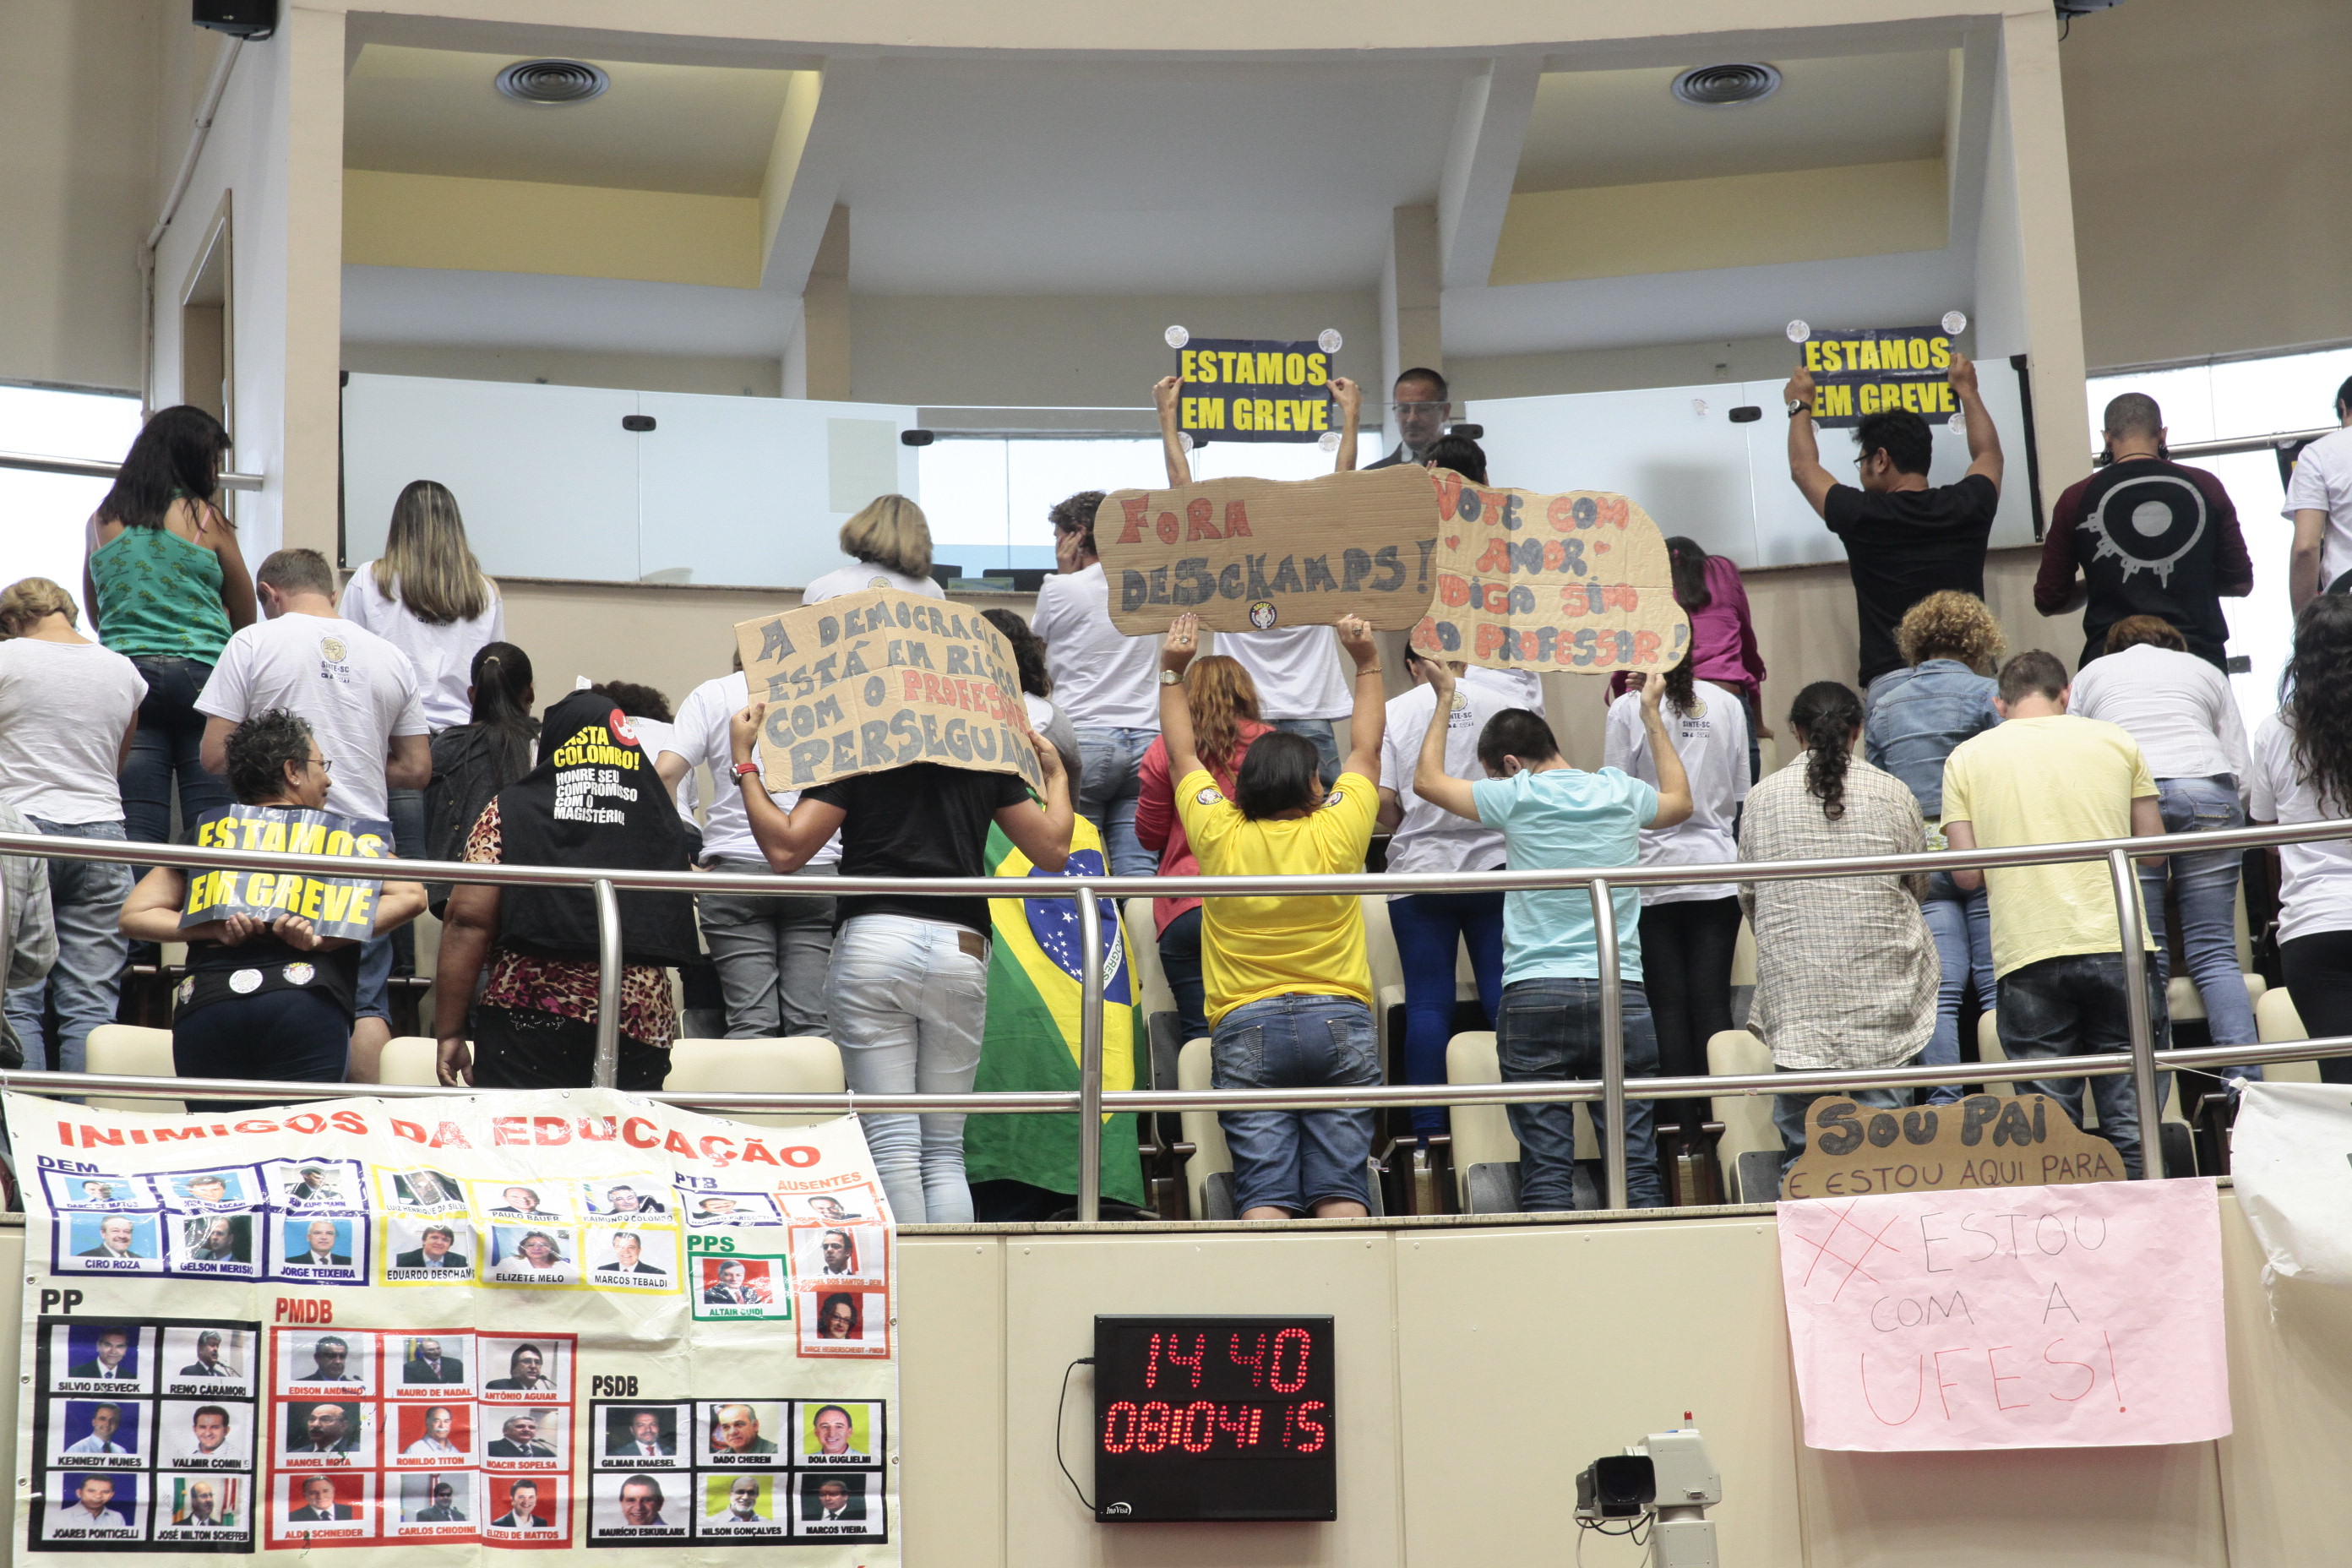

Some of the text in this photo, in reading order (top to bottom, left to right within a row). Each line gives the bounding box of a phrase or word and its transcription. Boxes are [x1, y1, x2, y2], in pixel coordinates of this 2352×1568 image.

[1805, 336, 1951, 372] ESTAMOS
[1181, 350, 1327, 386] ESTAMOS
[1810, 382, 1956, 417] EM GREVE
[1182, 397, 1328, 432] EM GREVE
[1432, 472, 1630, 532] VOTE COM
[1116, 493, 1252, 544] FORA
[1475, 538, 1587, 576] AMOR
[1121, 538, 1436, 612] DESCHAMPS!
[756, 618, 797, 665] A
[1411, 616, 1462, 651] AO
[767, 640, 870, 704] ESTÁ
[887, 639, 935, 670] EM
[765, 669, 1029, 749] COM O PROFESSOR
[561, 726, 609, 747] ASTA
[553, 744, 640, 770] COLOMBO!
[556, 768, 619, 786] HONRE SEU
[556, 781, 638, 802] COMPROMISSO
[555, 794, 594, 808] COM O
[553, 807, 625, 825] MAGISTÉRIO!
[198, 817, 382, 858] ESTAMOS
[188, 871, 373, 925] EM GREVE
[1816, 1102, 1938, 1155] SOU
[57, 1110, 821, 1168] INIMIGOS DA EDUCAÇÃO
[37, 1154, 100, 1173] DEM
[675, 1171, 718, 1190] PTB
[777, 1171, 862, 1191] AUSENTES
[1788, 1152, 2115, 1199] E ESTOU AQUI PARA
[492, 1211, 524, 1220] PAULO
[687, 1234, 735, 1252] PPS
[85, 1260, 140, 1269] CIRO ROZA
[181, 1262, 253, 1274] GELSON MERISIO
[280, 1267, 356, 1278] JORGE TEIXEIRA
[387, 1268, 475, 1280] EDUARDO DESCHAMS
[496, 1273, 564, 1282] ELIZETE MELO
[595, 1275, 667, 1288] MARCOS TEBALDI
[41, 1288, 84, 1314] PP
[1871, 1282, 2079, 1332] COM A
[275, 1297, 333, 1324] PMDB
[1146, 1328, 1311, 1392] 14 40
[58, 1381, 140, 1392] SILVIO DREVECK
[591, 1375, 639, 1396] PSDB
[1861, 1330, 2126, 1426] UFES!
[170, 1384, 246, 1396] RENO CARAMORI
[288, 1386, 321, 1395] EDISON
[396, 1388, 472, 1396] MAURO DE NADAL
[485, 1391, 557, 1401] ANTÔNIO AGUIAR
[58, 1456, 142, 1467] KENNEDY NUNES
[172, 1458, 242, 1468] VALMIR COMIN
[286, 1458, 324, 1467] MANOEL
[396, 1456, 465, 1466] ROMILDO TITON
[486, 1460, 558, 1469] MOACIR SOPELSA
[602, 1459, 676, 1467] GILMAR KNAESEL
[713, 1456, 771, 1464] DADO CHEREM
[829, 1456, 871, 1464] GUGLIELMI
[52, 1528, 139, 1538] JOARES PONTICELLI
[158, 1527, 248, 1541] JOSÉ MILTON SCHEFFER
[285, 1528, 363, 1538] ALDO SCHNEIDER
[398, 1525, 476, 1535] CARLOS CHIODINI
[487, 1530, 558, 1539] ELIZEU DE MATTOS
[598, 1527, 637, 1536] MAURÍCIO
[701, 1526, 782, 1537] NILSON GONÇALVES
[806, 1526, 868, 1534] MARCOS VIEIRA
